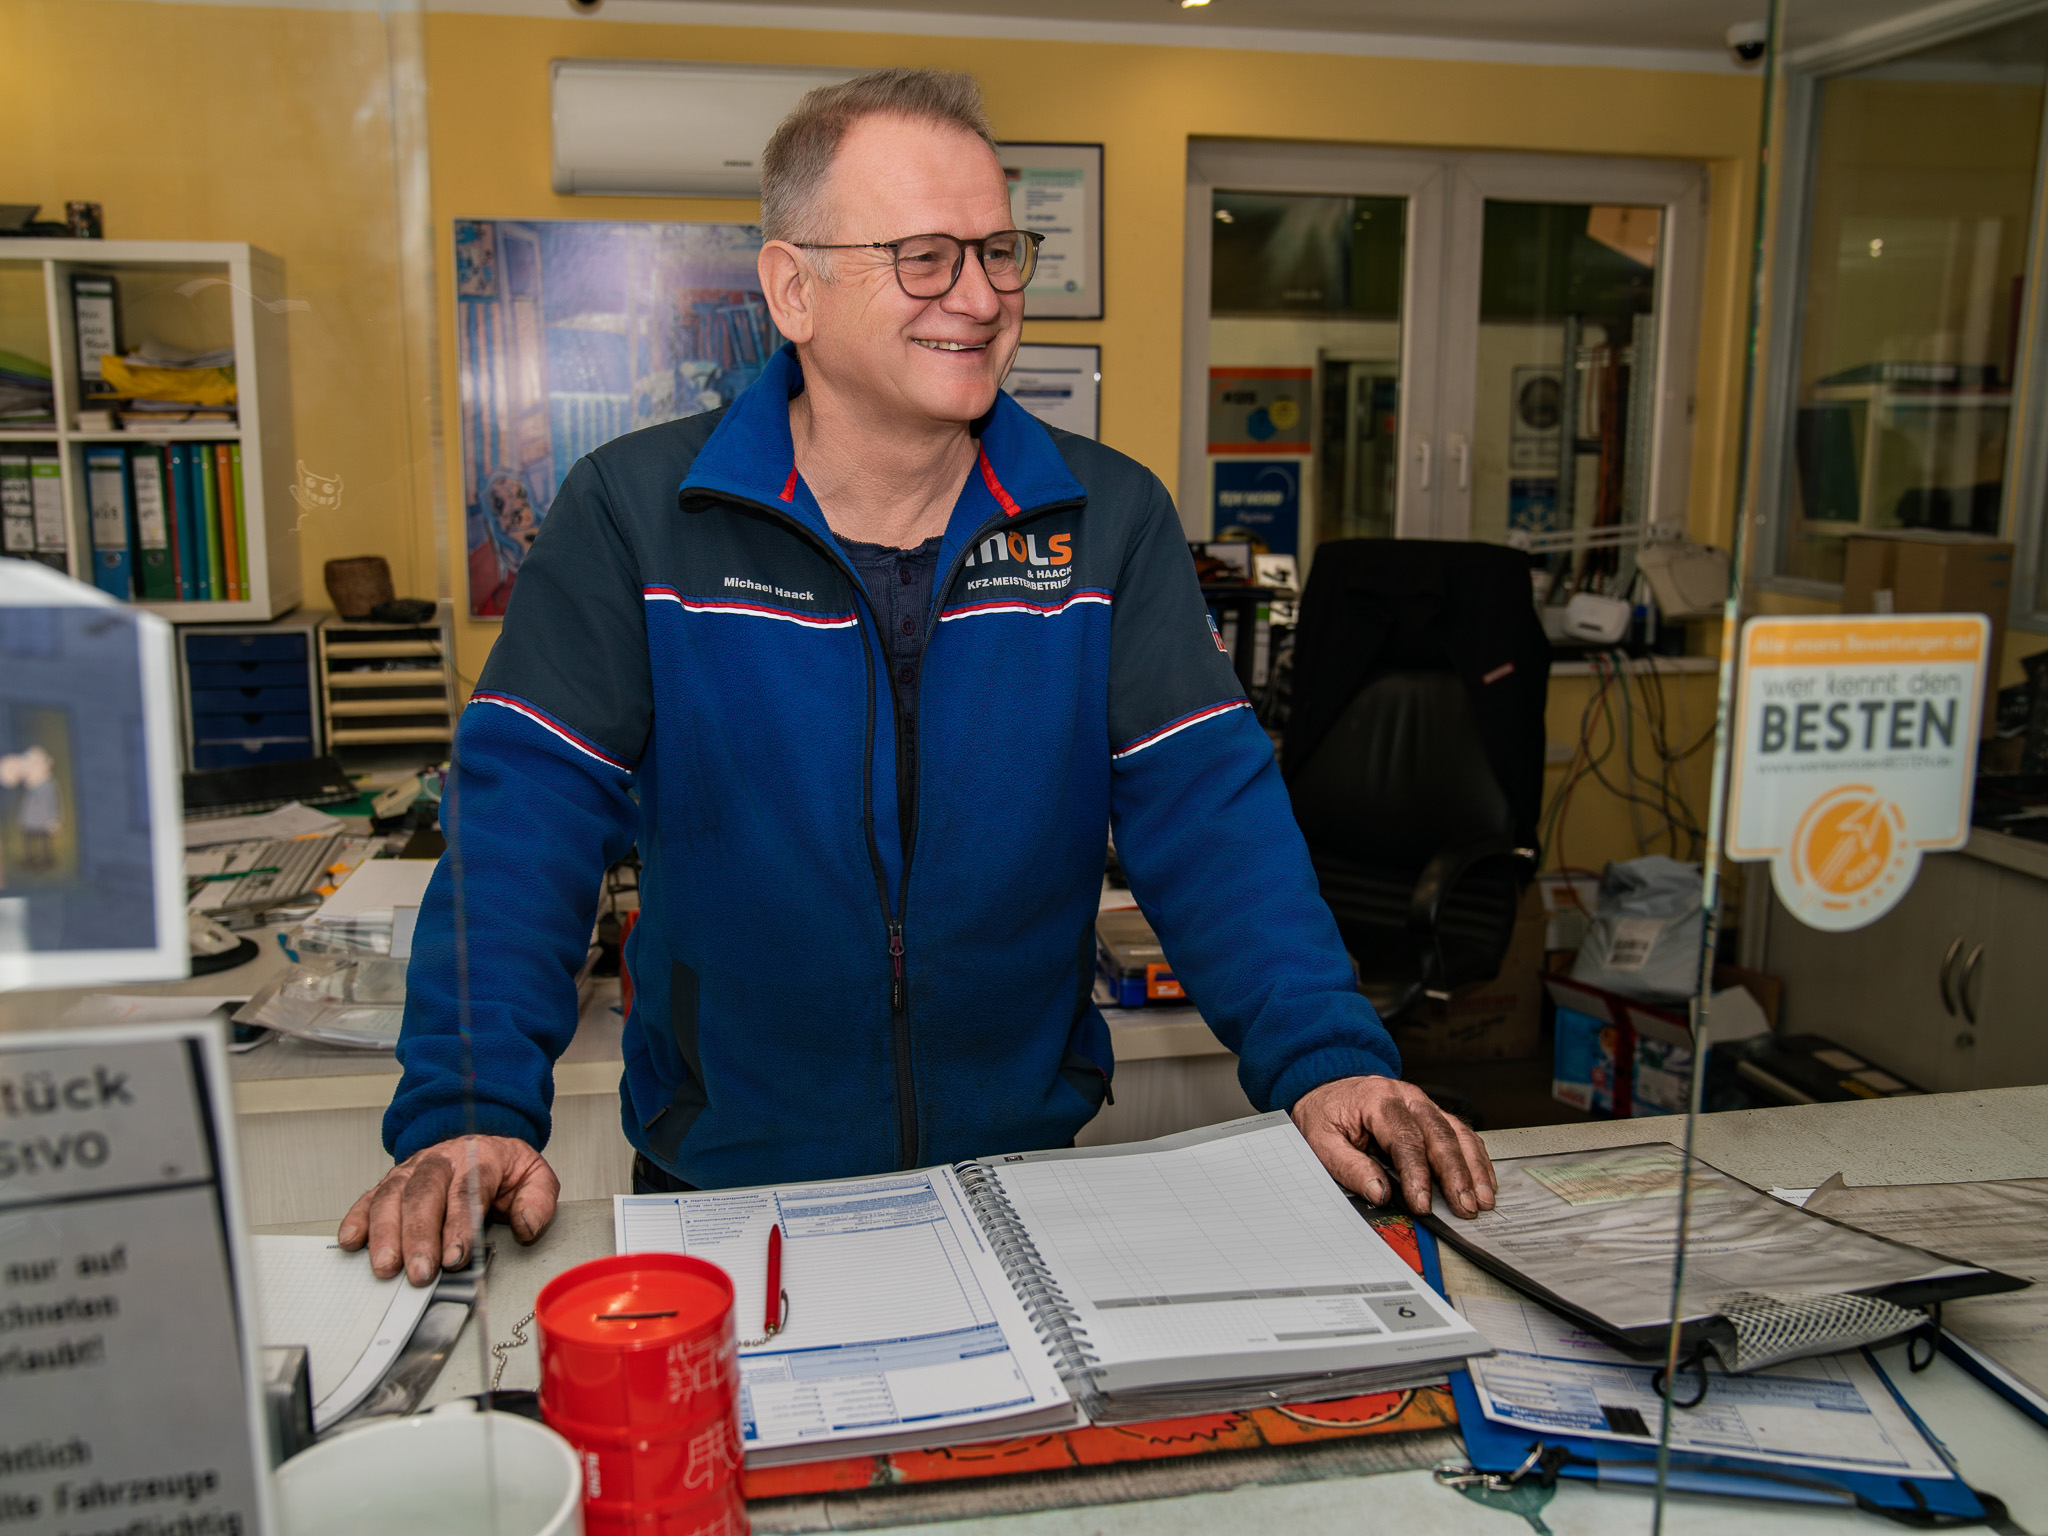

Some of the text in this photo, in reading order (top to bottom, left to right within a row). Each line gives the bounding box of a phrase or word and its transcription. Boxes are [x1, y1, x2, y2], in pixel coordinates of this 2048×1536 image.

[724, 577, 815, 601] Michael Haack
[1027, 565, 1072, 579] & HAACK
[1762, 669, 1963, 699] wer kennt den
[1759, 700, 1958, 754] BESTEN
[6, 1243, 128, 1287] nur auf
[54, 1470, 219, 1515] Fahrzeuge
